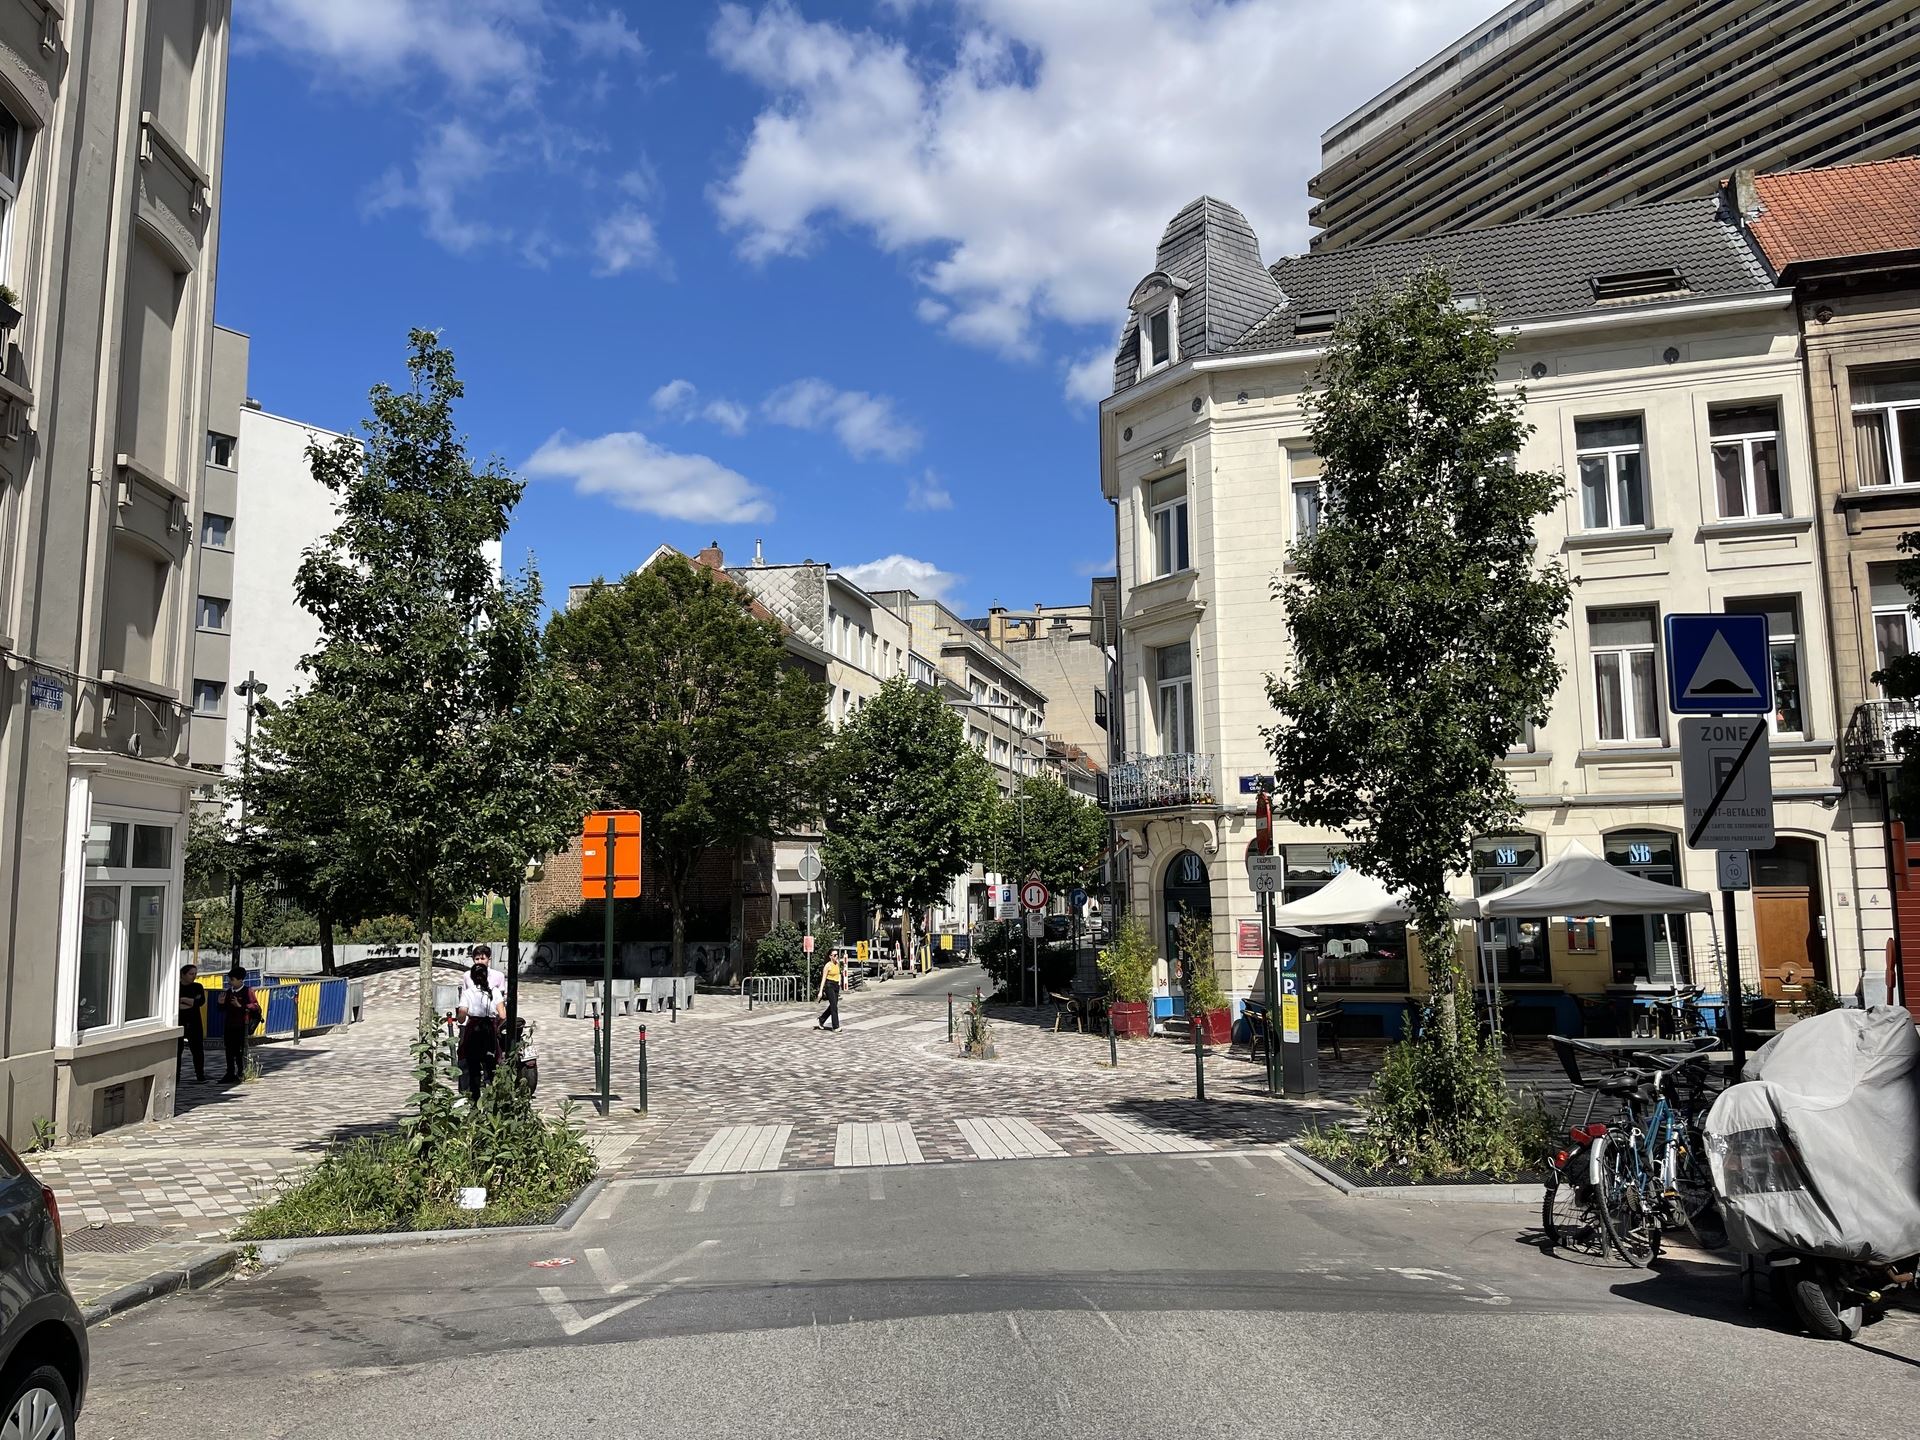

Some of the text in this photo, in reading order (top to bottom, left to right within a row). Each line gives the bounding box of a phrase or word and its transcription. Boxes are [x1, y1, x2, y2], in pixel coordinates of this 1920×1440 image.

[1701, 727, 1748, 741] ZONE
[1693, 808, 1767, 817] PAYT-BETALEND
[1730, 868, 1739, 876] 10
[1003, 890, 1010, 901] P
[1870, 894, 1879, 905] 4
[1283, 952, 1292, 967] P
[1159, 978, 1168, 987] 36
[1283, 978, 1295, 994] P
